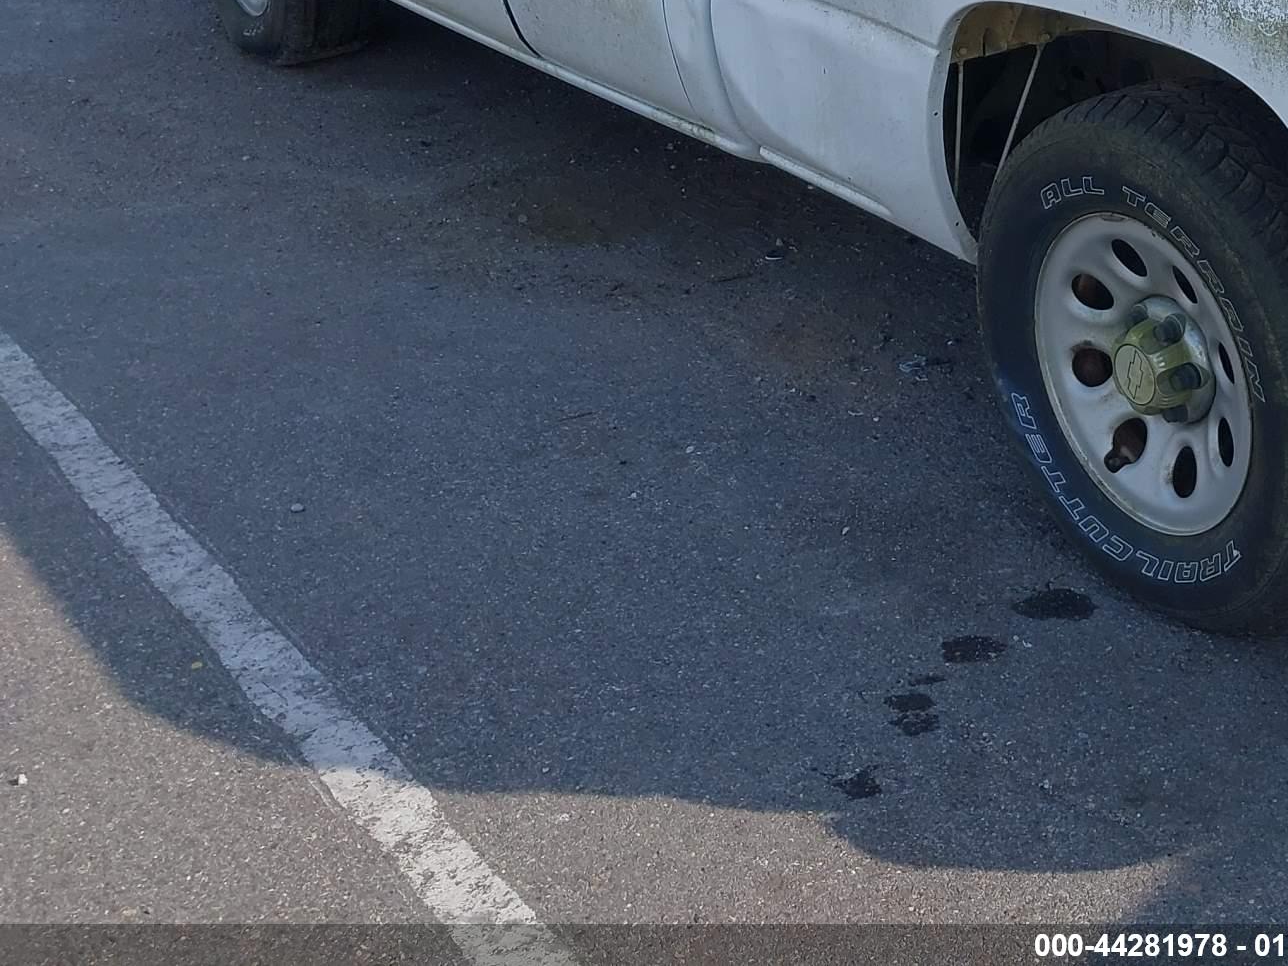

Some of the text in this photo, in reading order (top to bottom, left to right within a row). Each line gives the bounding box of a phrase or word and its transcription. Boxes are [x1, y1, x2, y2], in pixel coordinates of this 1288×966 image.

[1040, 177, 1266, 403] ALL TERRAIN
[1010, 392, 1243, 583] TRAILCUTTER
